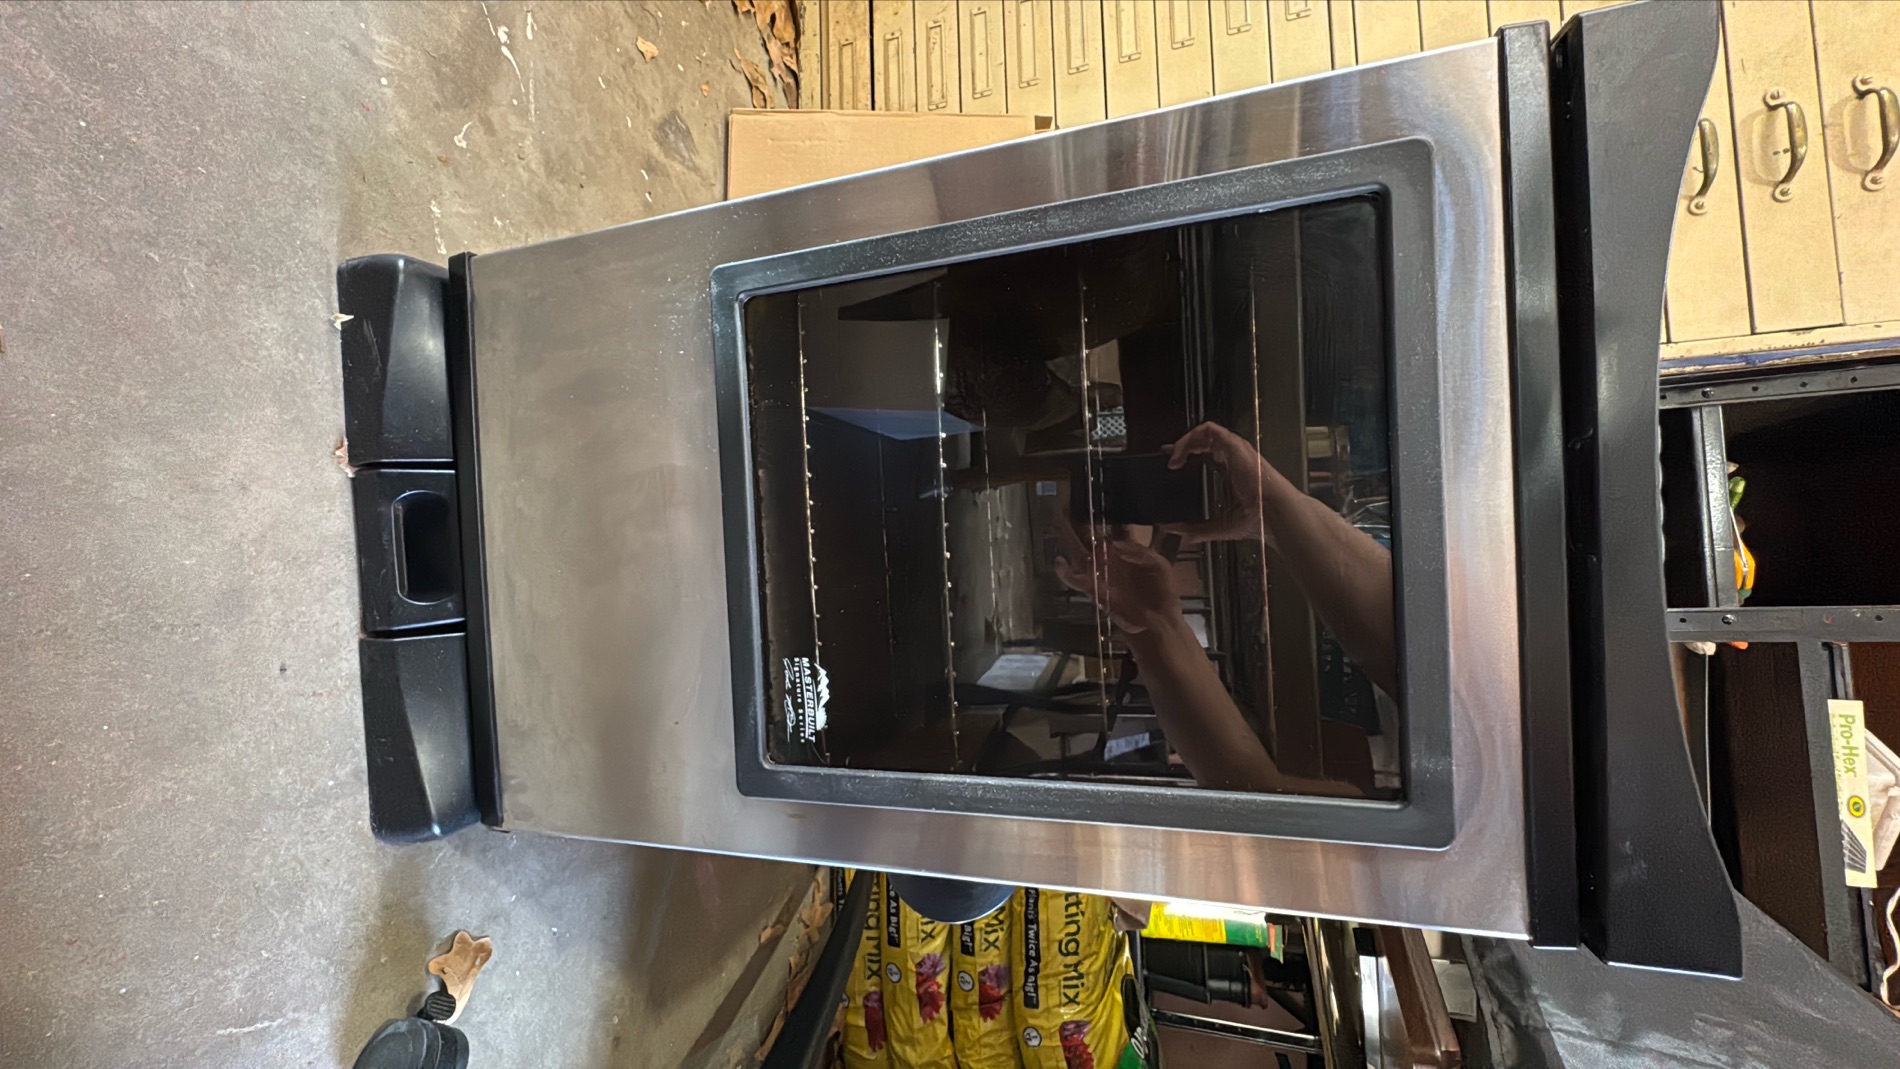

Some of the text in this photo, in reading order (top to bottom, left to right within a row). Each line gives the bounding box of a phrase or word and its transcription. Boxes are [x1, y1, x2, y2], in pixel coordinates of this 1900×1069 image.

[793, 657, 802, 703] Signature
[801, 657, 816, 743] MASTERBUILT
[1838, 713, 1860, 775] Pro-Hex
[983, 905, 1006, 952] Mix
[1027, 923, 1038, 957] Twice
[1028, 960, 1038, 975] As
[1062, 959, 1085, 1008] Mix
